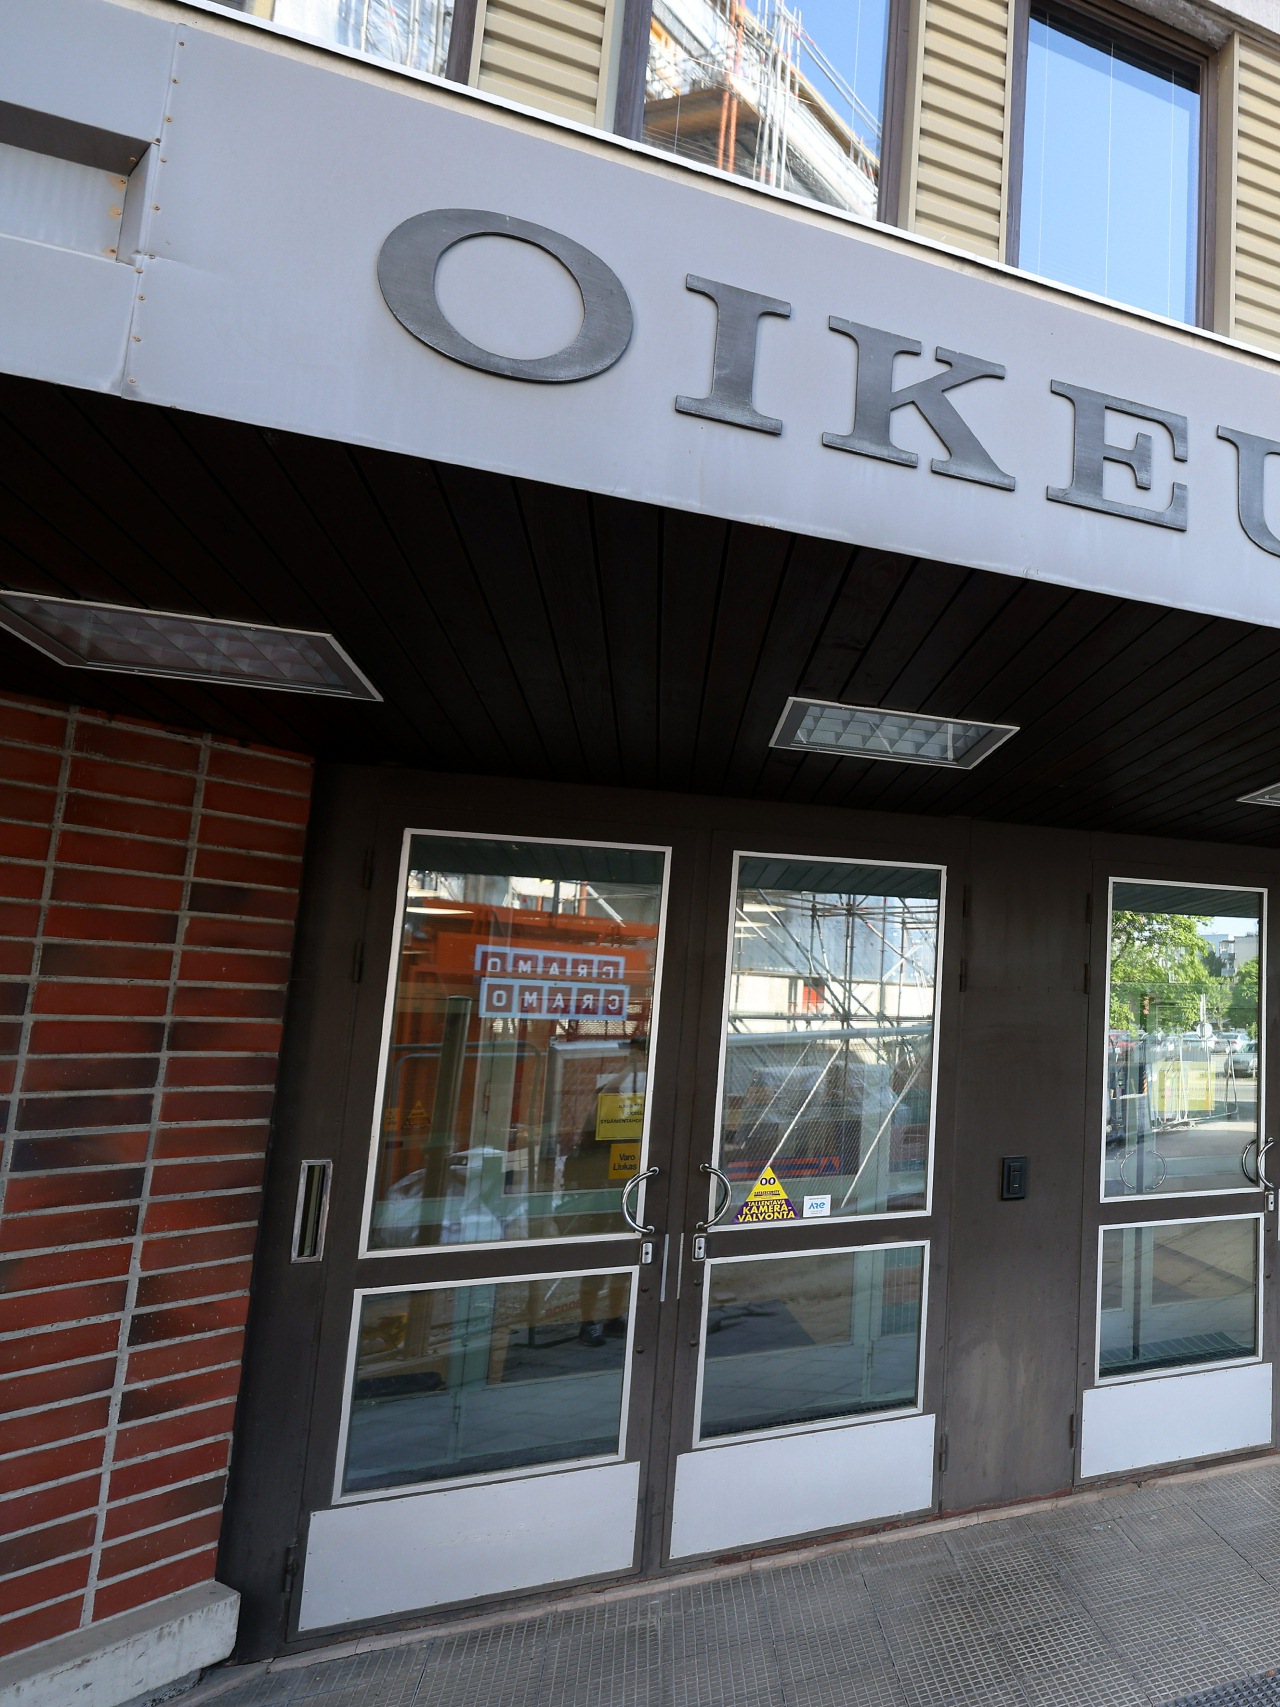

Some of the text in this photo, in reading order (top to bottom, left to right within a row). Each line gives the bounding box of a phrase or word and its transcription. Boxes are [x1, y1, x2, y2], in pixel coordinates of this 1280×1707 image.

[613, 1163, 637, 1171] Liukas
[743, 1204, 792, 1214] KAMERA-
[737, 1211, 795, 1222] VALVONTA
